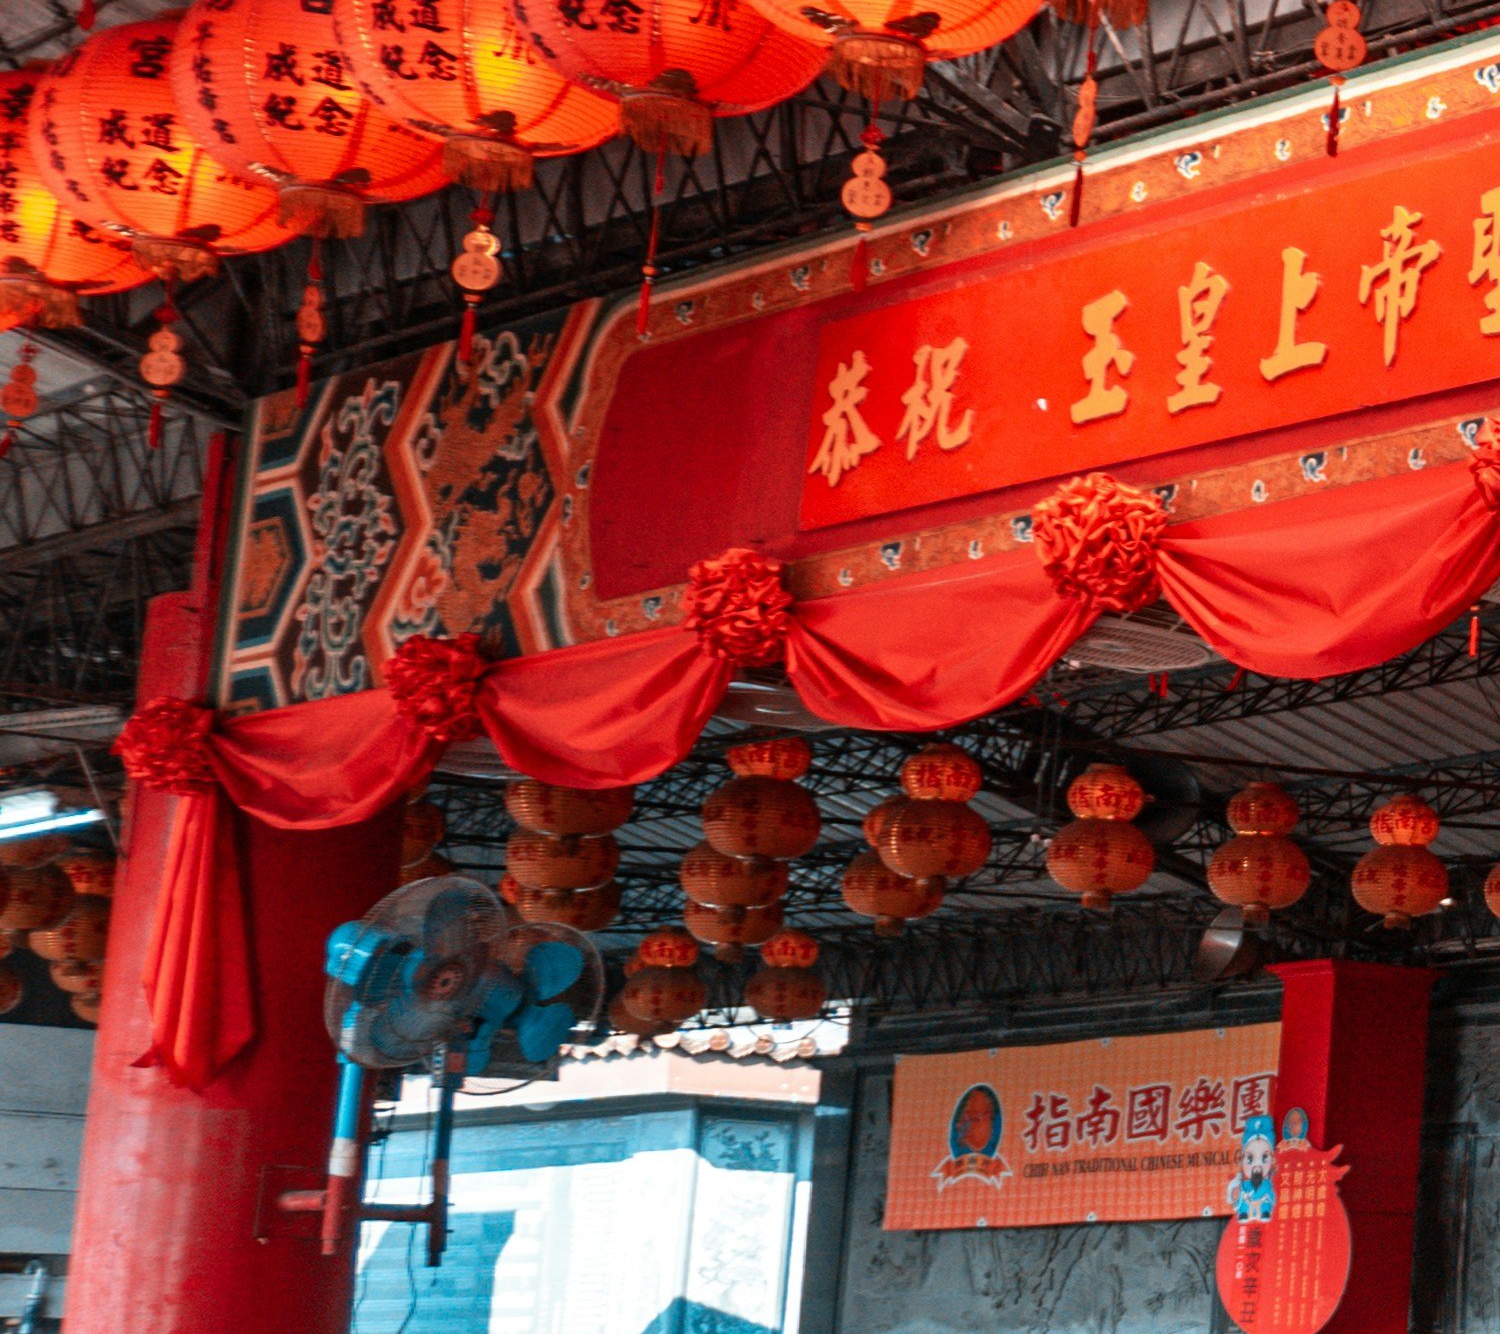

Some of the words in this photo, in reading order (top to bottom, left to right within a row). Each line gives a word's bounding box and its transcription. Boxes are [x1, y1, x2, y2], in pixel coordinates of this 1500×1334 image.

[261, 42, 353, 92] 成道
[378, 39, 458, 83] 紀念
[98, 110, 180, 152] 成道
[262, 94, 354, 136] 紀念
[101, 157, 185, 196] 紀念
[806, 335, 975, 487] 恭祝
[1023, 1072, 1279, 1150] 指南國樂團
[1140, 1152, 1184, 1170] CHINESE
